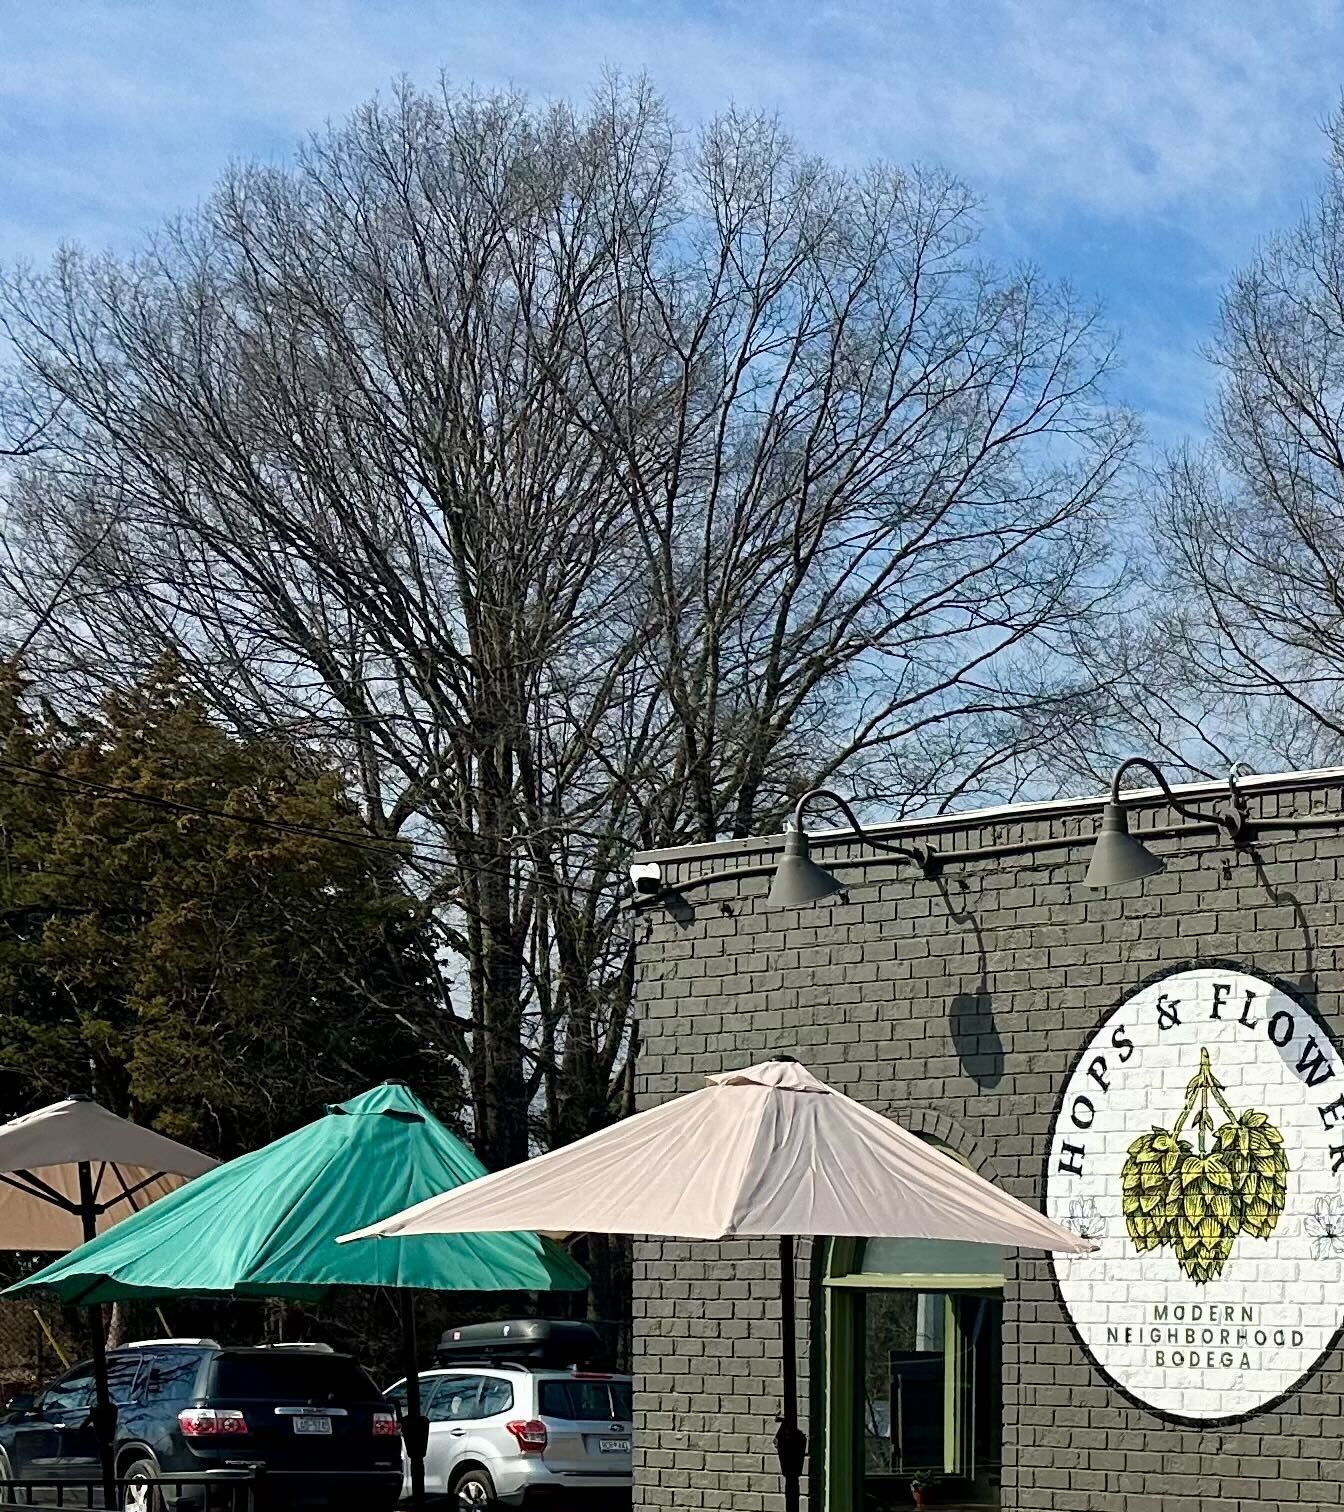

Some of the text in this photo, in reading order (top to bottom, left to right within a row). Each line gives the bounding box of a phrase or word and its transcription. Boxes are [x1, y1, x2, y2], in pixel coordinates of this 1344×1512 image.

[1058, 1025, 1135, 1177] HOPS
[1157, 993, 1182, 1030] &
[1153, 1304, 1254, 1322] MODERN
[1106, 1327, 1304, 1346] NEIGHBORHOOD
[1155, 1351, 1252, 1370] BODEGA
